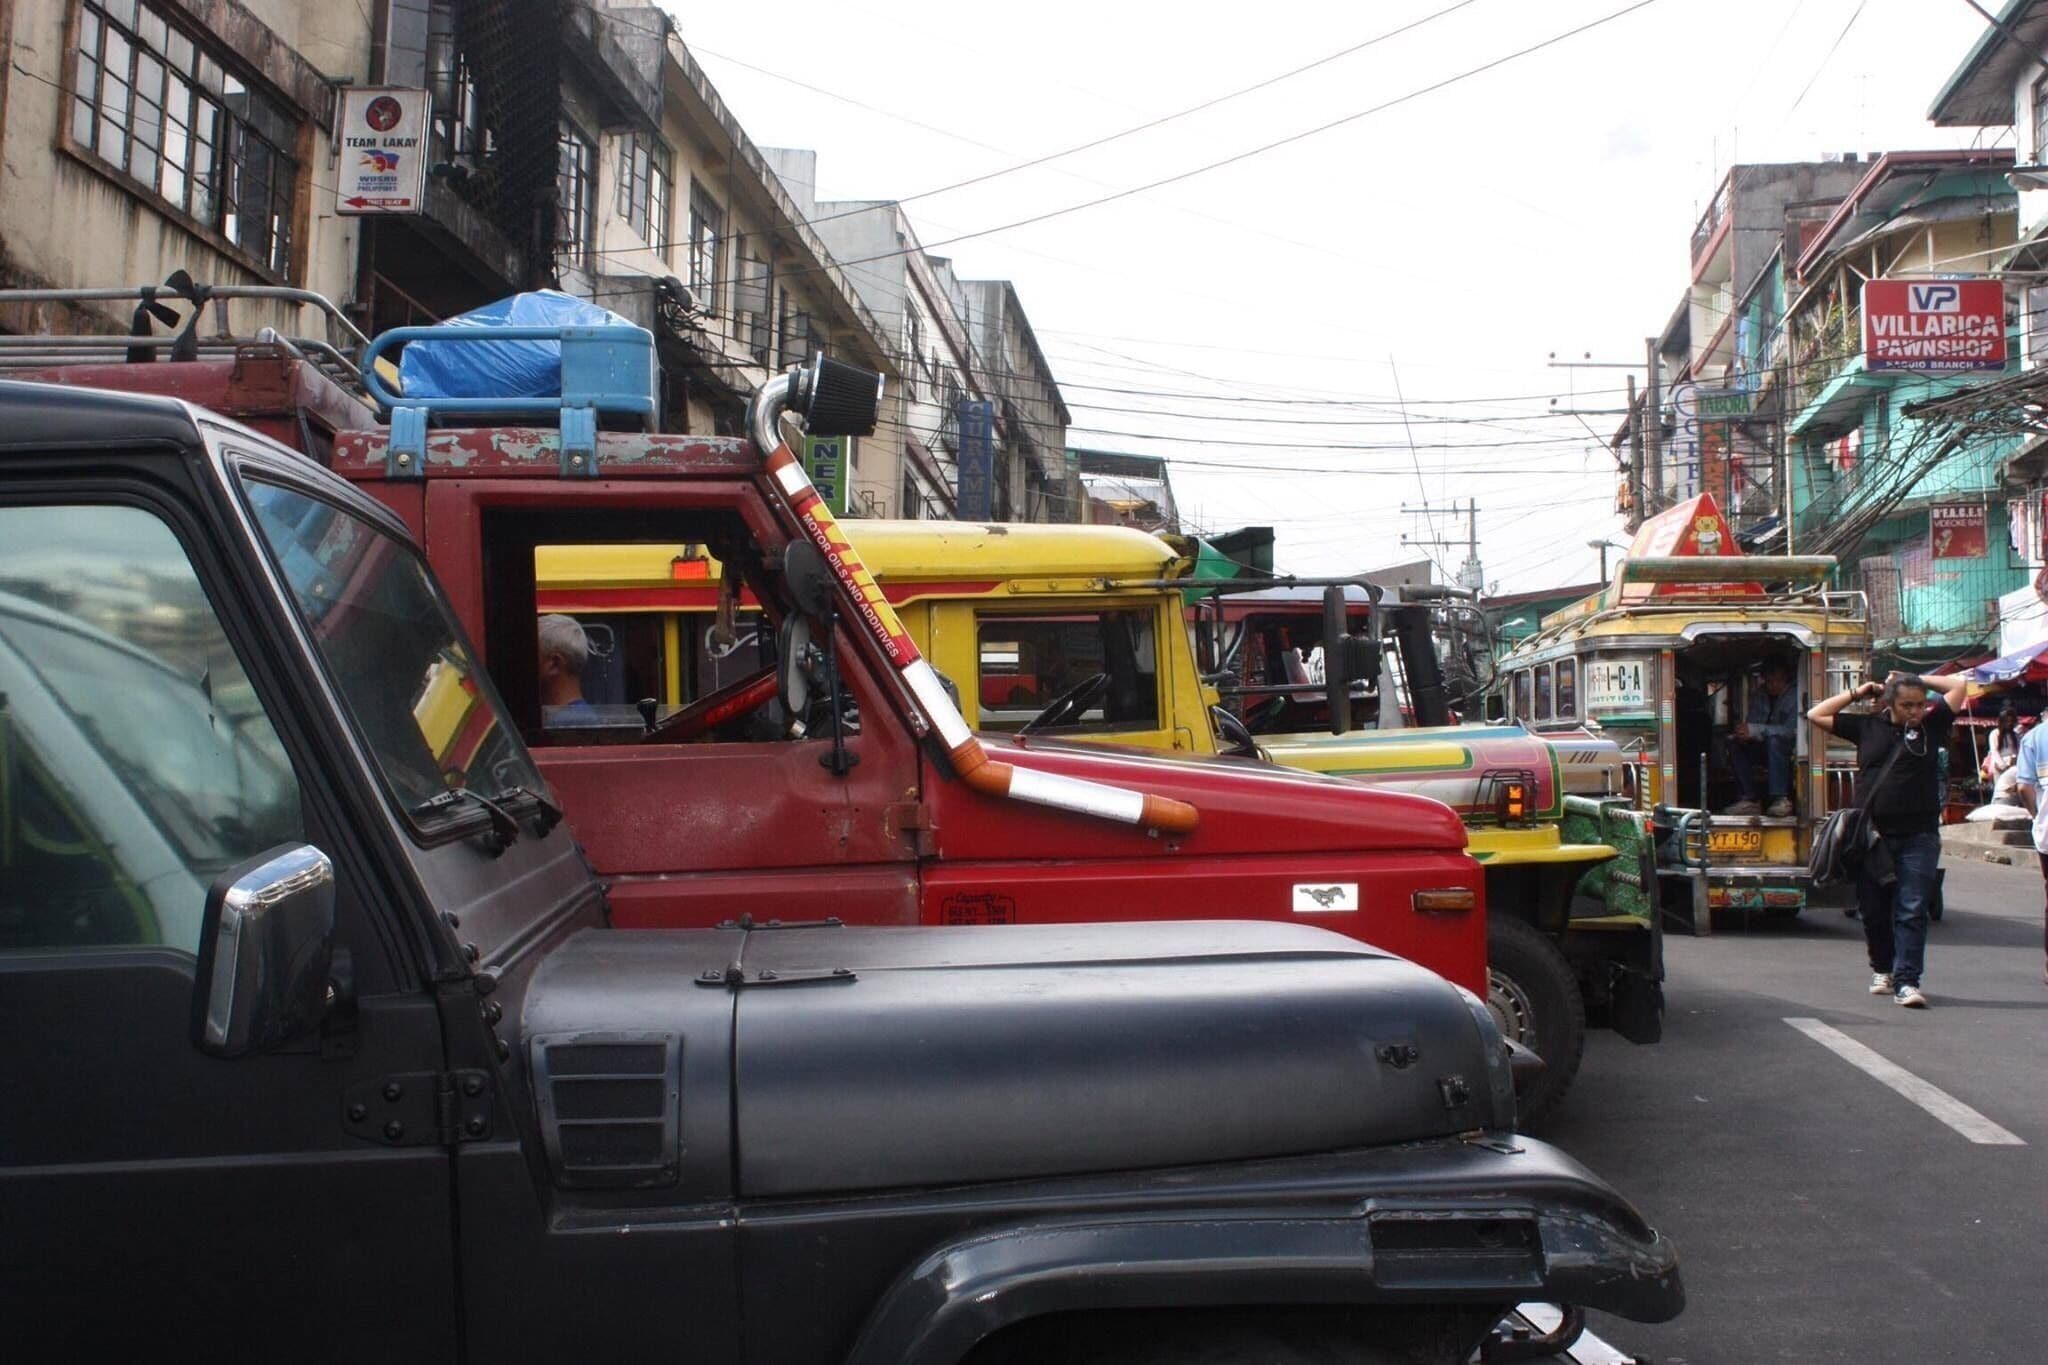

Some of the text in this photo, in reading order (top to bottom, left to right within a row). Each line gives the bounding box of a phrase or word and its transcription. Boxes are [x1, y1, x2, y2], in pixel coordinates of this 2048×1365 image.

[346, 138, 418, 147] TEAM LAKAY
[1912, 286, 1957, 310] VP
[1871, 315, 1999, 337] VILLARICA
[1876, 339, 1993, 357] PAWNSHOP
[1930, 361, 1974, 369] BRANCH
[801, 512, 900, 658] MOTOR OILS AND ADDITIVES
